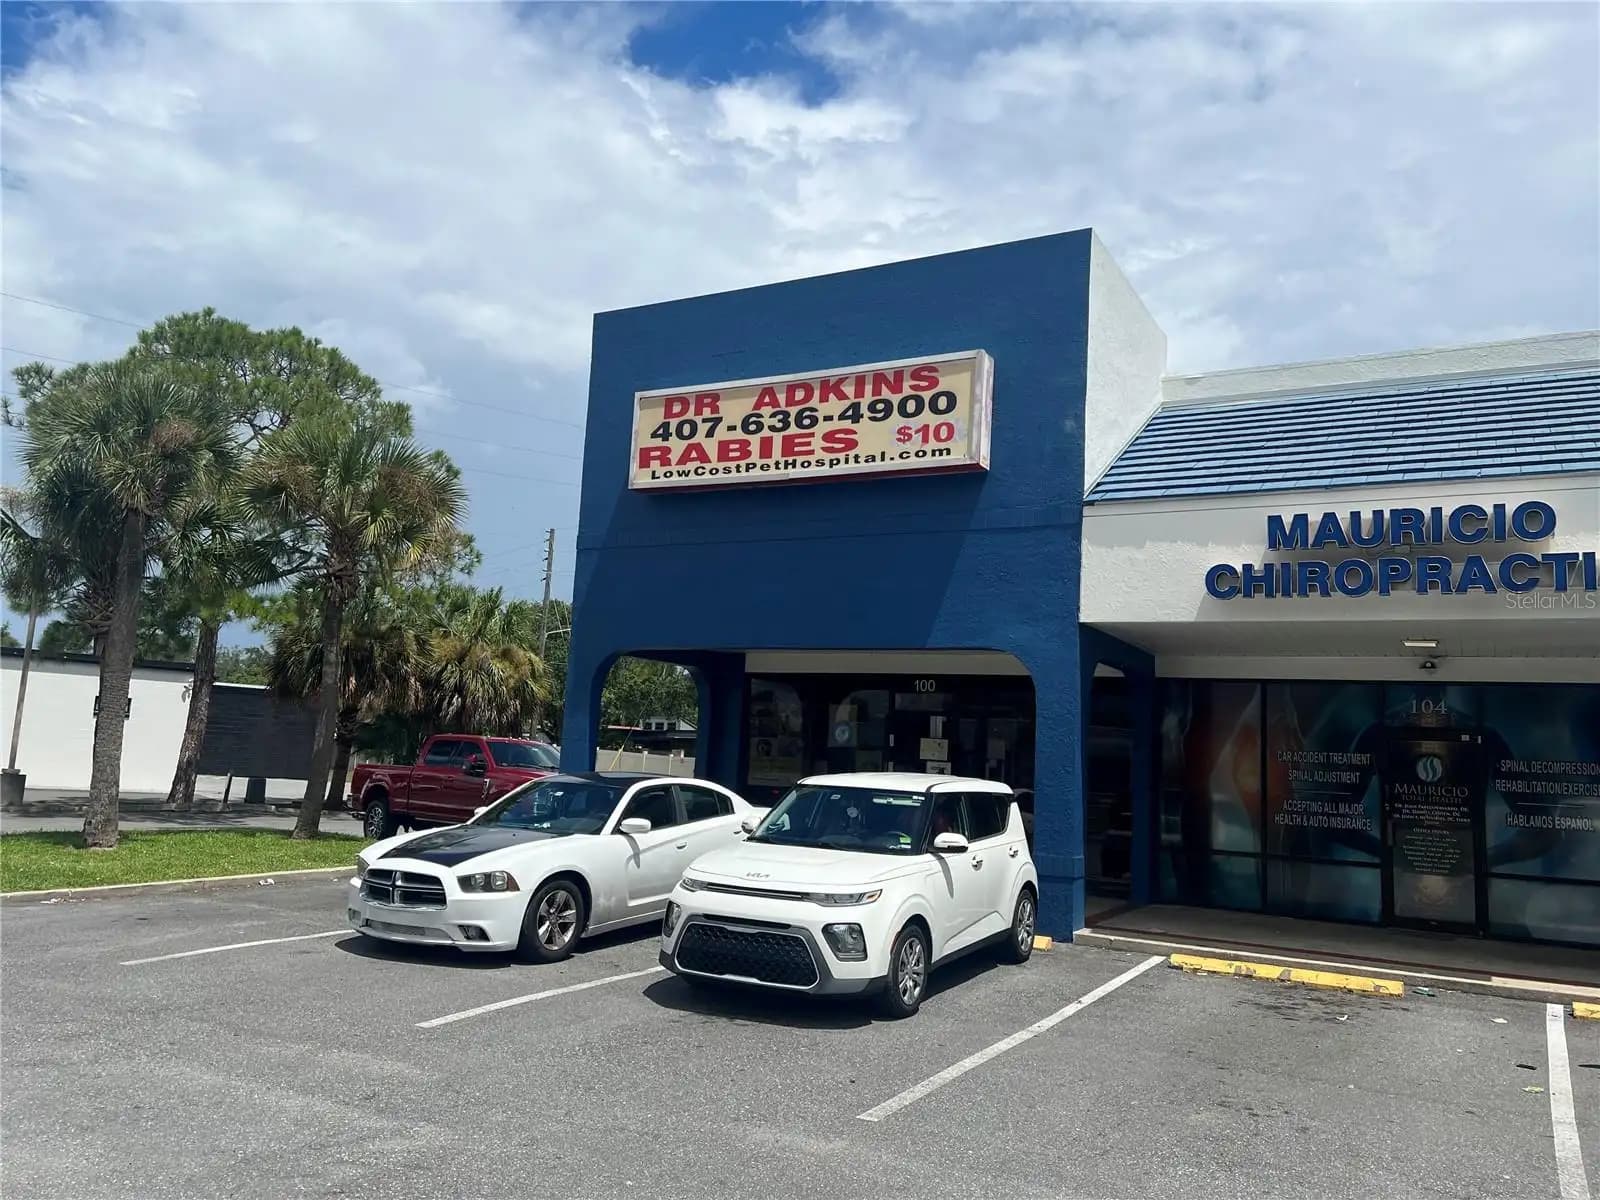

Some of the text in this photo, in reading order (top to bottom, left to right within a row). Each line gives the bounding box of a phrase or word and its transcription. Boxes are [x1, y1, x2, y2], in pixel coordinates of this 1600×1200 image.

[664, 365, 940, 420] DR ADKINS
[650, 390, 958, 442] 407-636-4900
[639, 421, 955, 469] RABIES $10
[651, 446, 951, 480] LowCostPetHospital.com
[1267, 501, 1557, 550] MAURICIO
[1205, 552, 1598, 600] CHIROPRACTI
[914, 679, 936, 692] 100
[1410, 699, 1448, 715] 104
[1277, 751, 1371, 765] CAR ACCIDENT TREATMENT
[1500, 759, 1530, 773] SPINAL
[1288, 769, 1360, 784] SPINAL ADJUSTMENT
[1394, 783, 1468, 798] MAURICIO
[1282, 799, 1364, 815] ACCEPTING ALL MAJOR
[1274, 813, 1372, 831] HEALTH & AUTO INSURANCE
[1507, 813, 1593, 831] HABLAMOS ESPAÑOL
